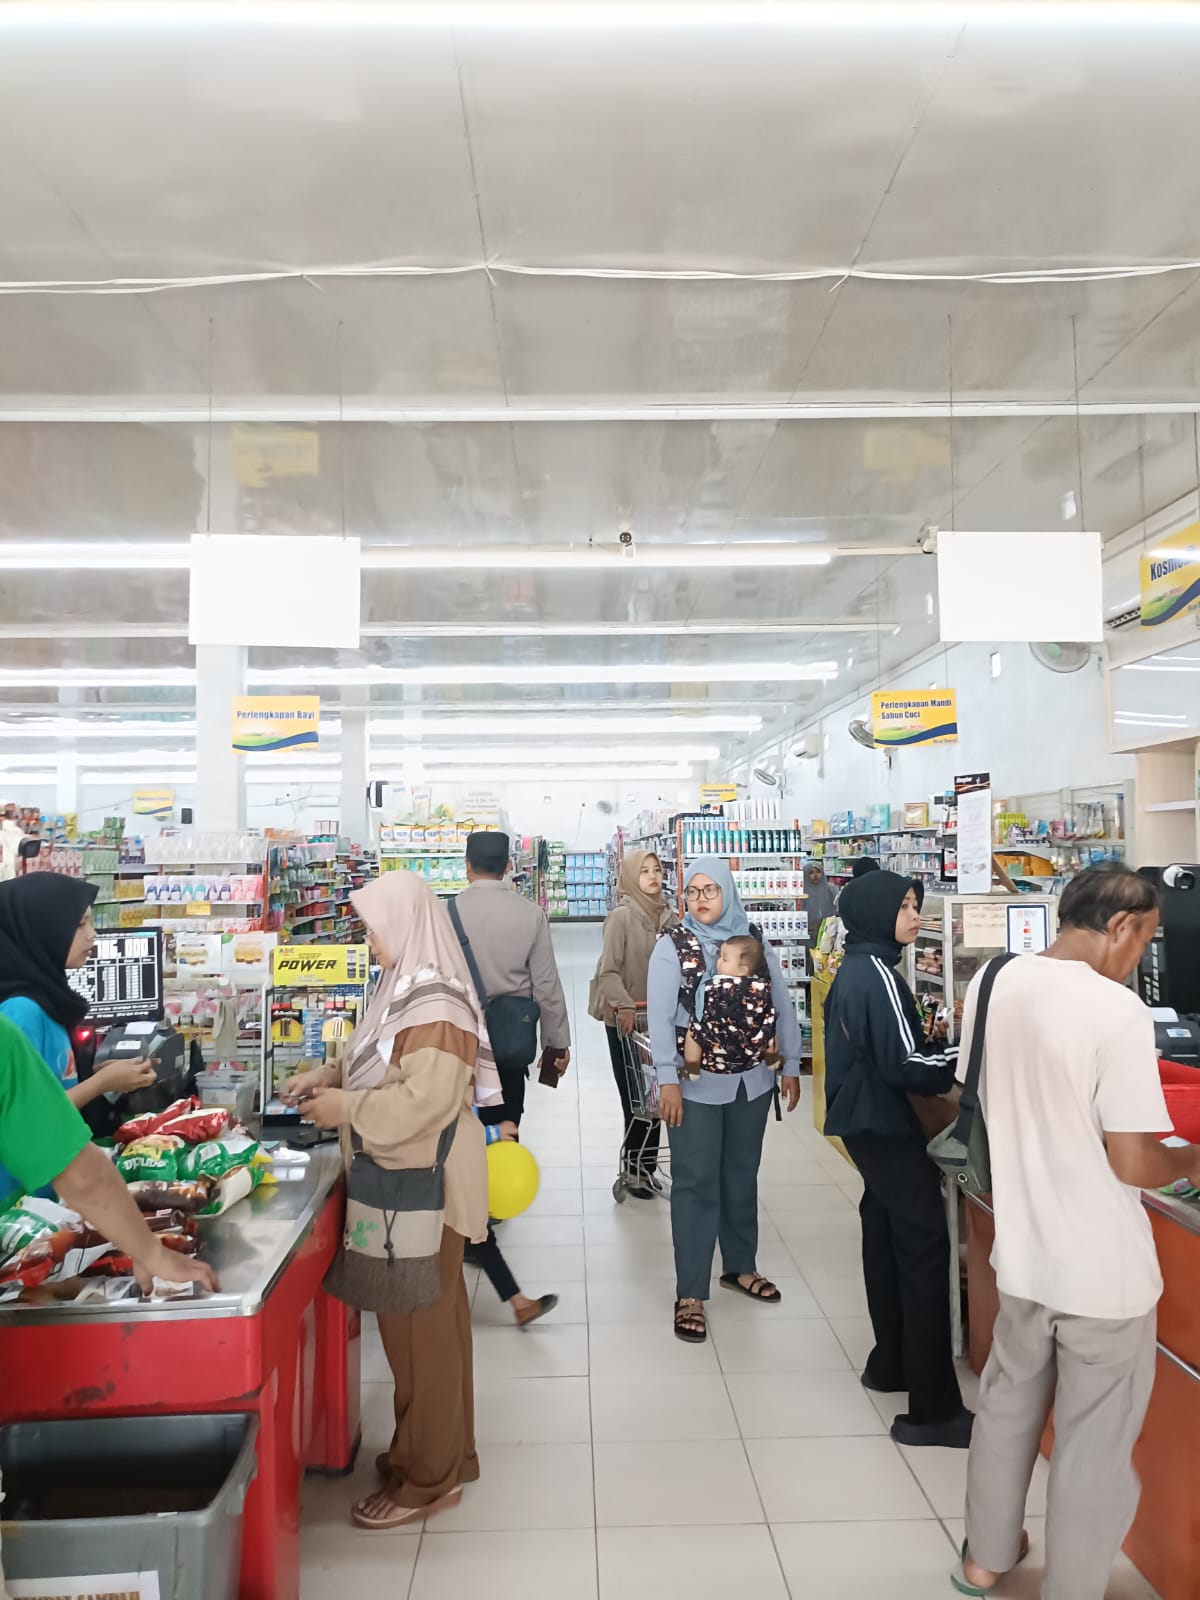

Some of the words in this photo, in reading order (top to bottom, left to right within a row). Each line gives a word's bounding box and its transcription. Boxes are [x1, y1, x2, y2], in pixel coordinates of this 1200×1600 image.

[880, 700, 929, 709] Perlengkapan
[930, 699, 952, 707] Mandi
[236, 710, 295, 720] Perlengkapan
[296, 710, 315, 720] Bayi
[881, 711, 903, 720] Sabun
[904, 711, 920, 719] Cuci
[277, 959, 337, 973] POWER
